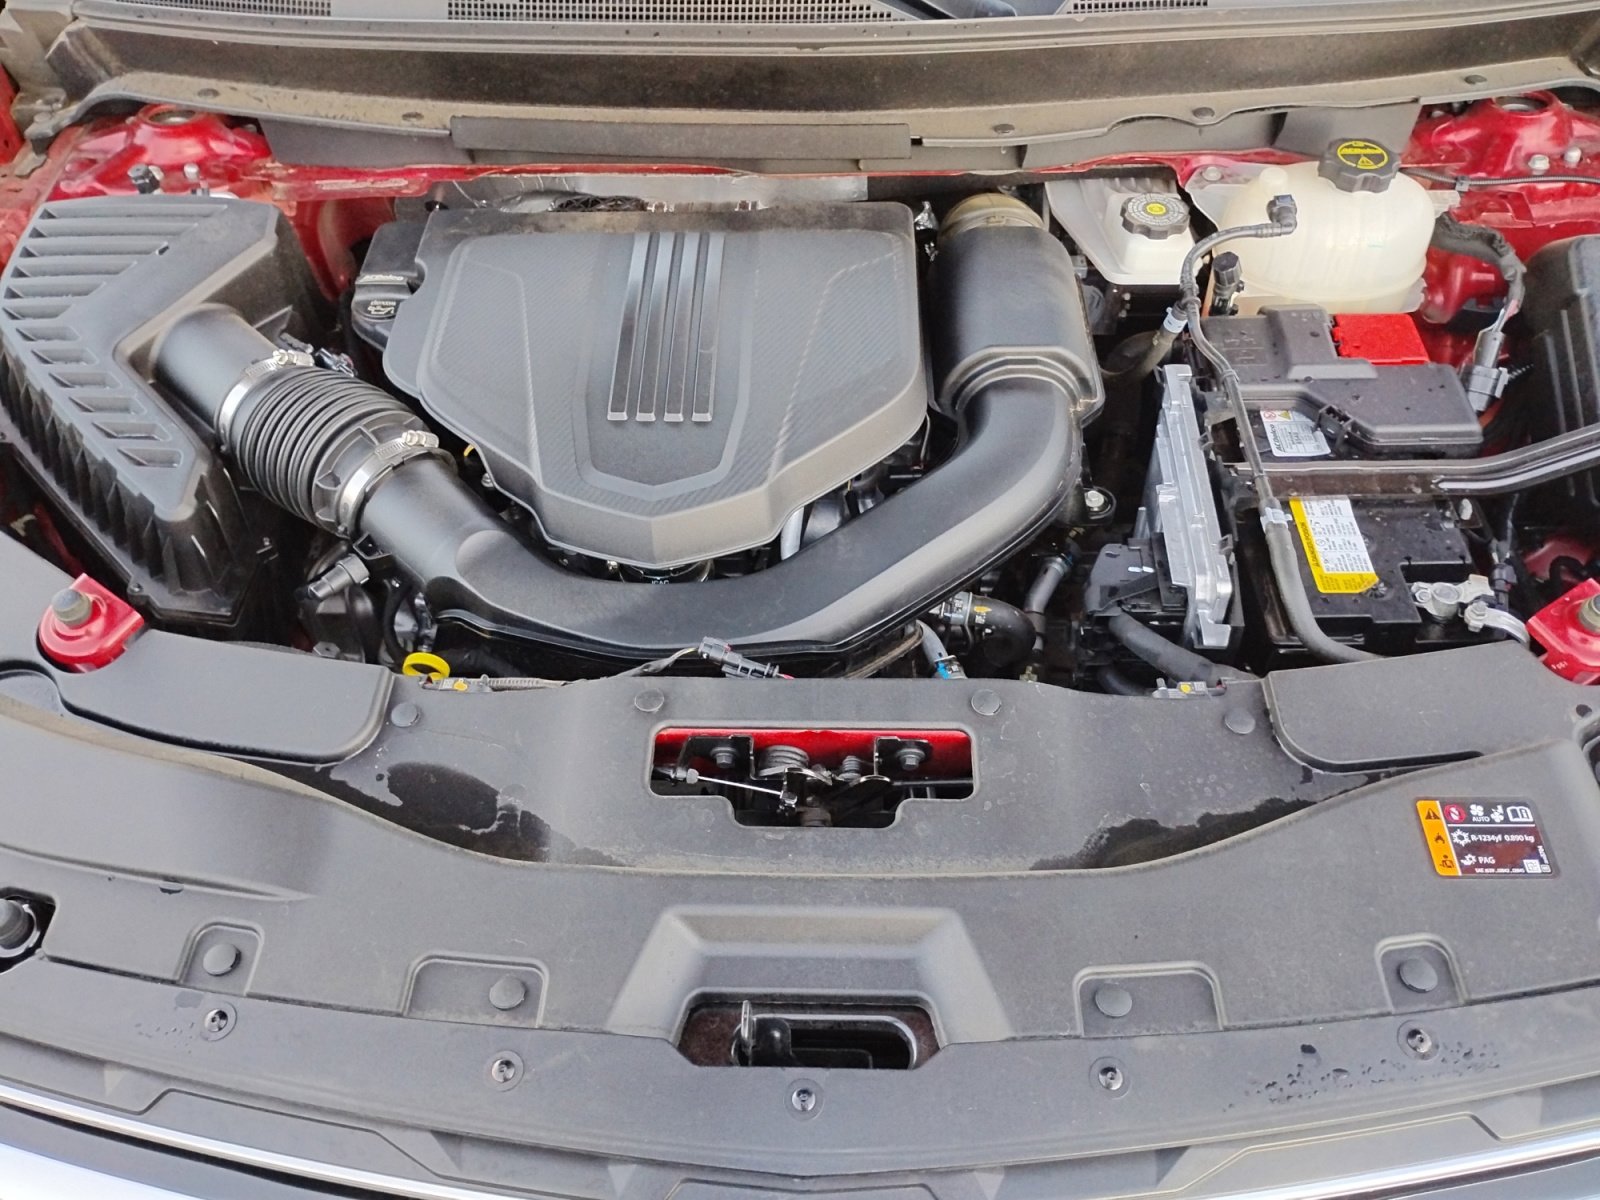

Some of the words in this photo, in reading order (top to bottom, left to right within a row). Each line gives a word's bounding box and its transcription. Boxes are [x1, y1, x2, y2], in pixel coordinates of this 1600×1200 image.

[1269, 423, 1286, 453] ACDelco
[1472, 815, 1490, 823] AUTO
[1470, 834, 1502, 843] R-1234yf
[1524, 834, 1535, 843] kg
[1477, 856, 1496, 864] PAG
